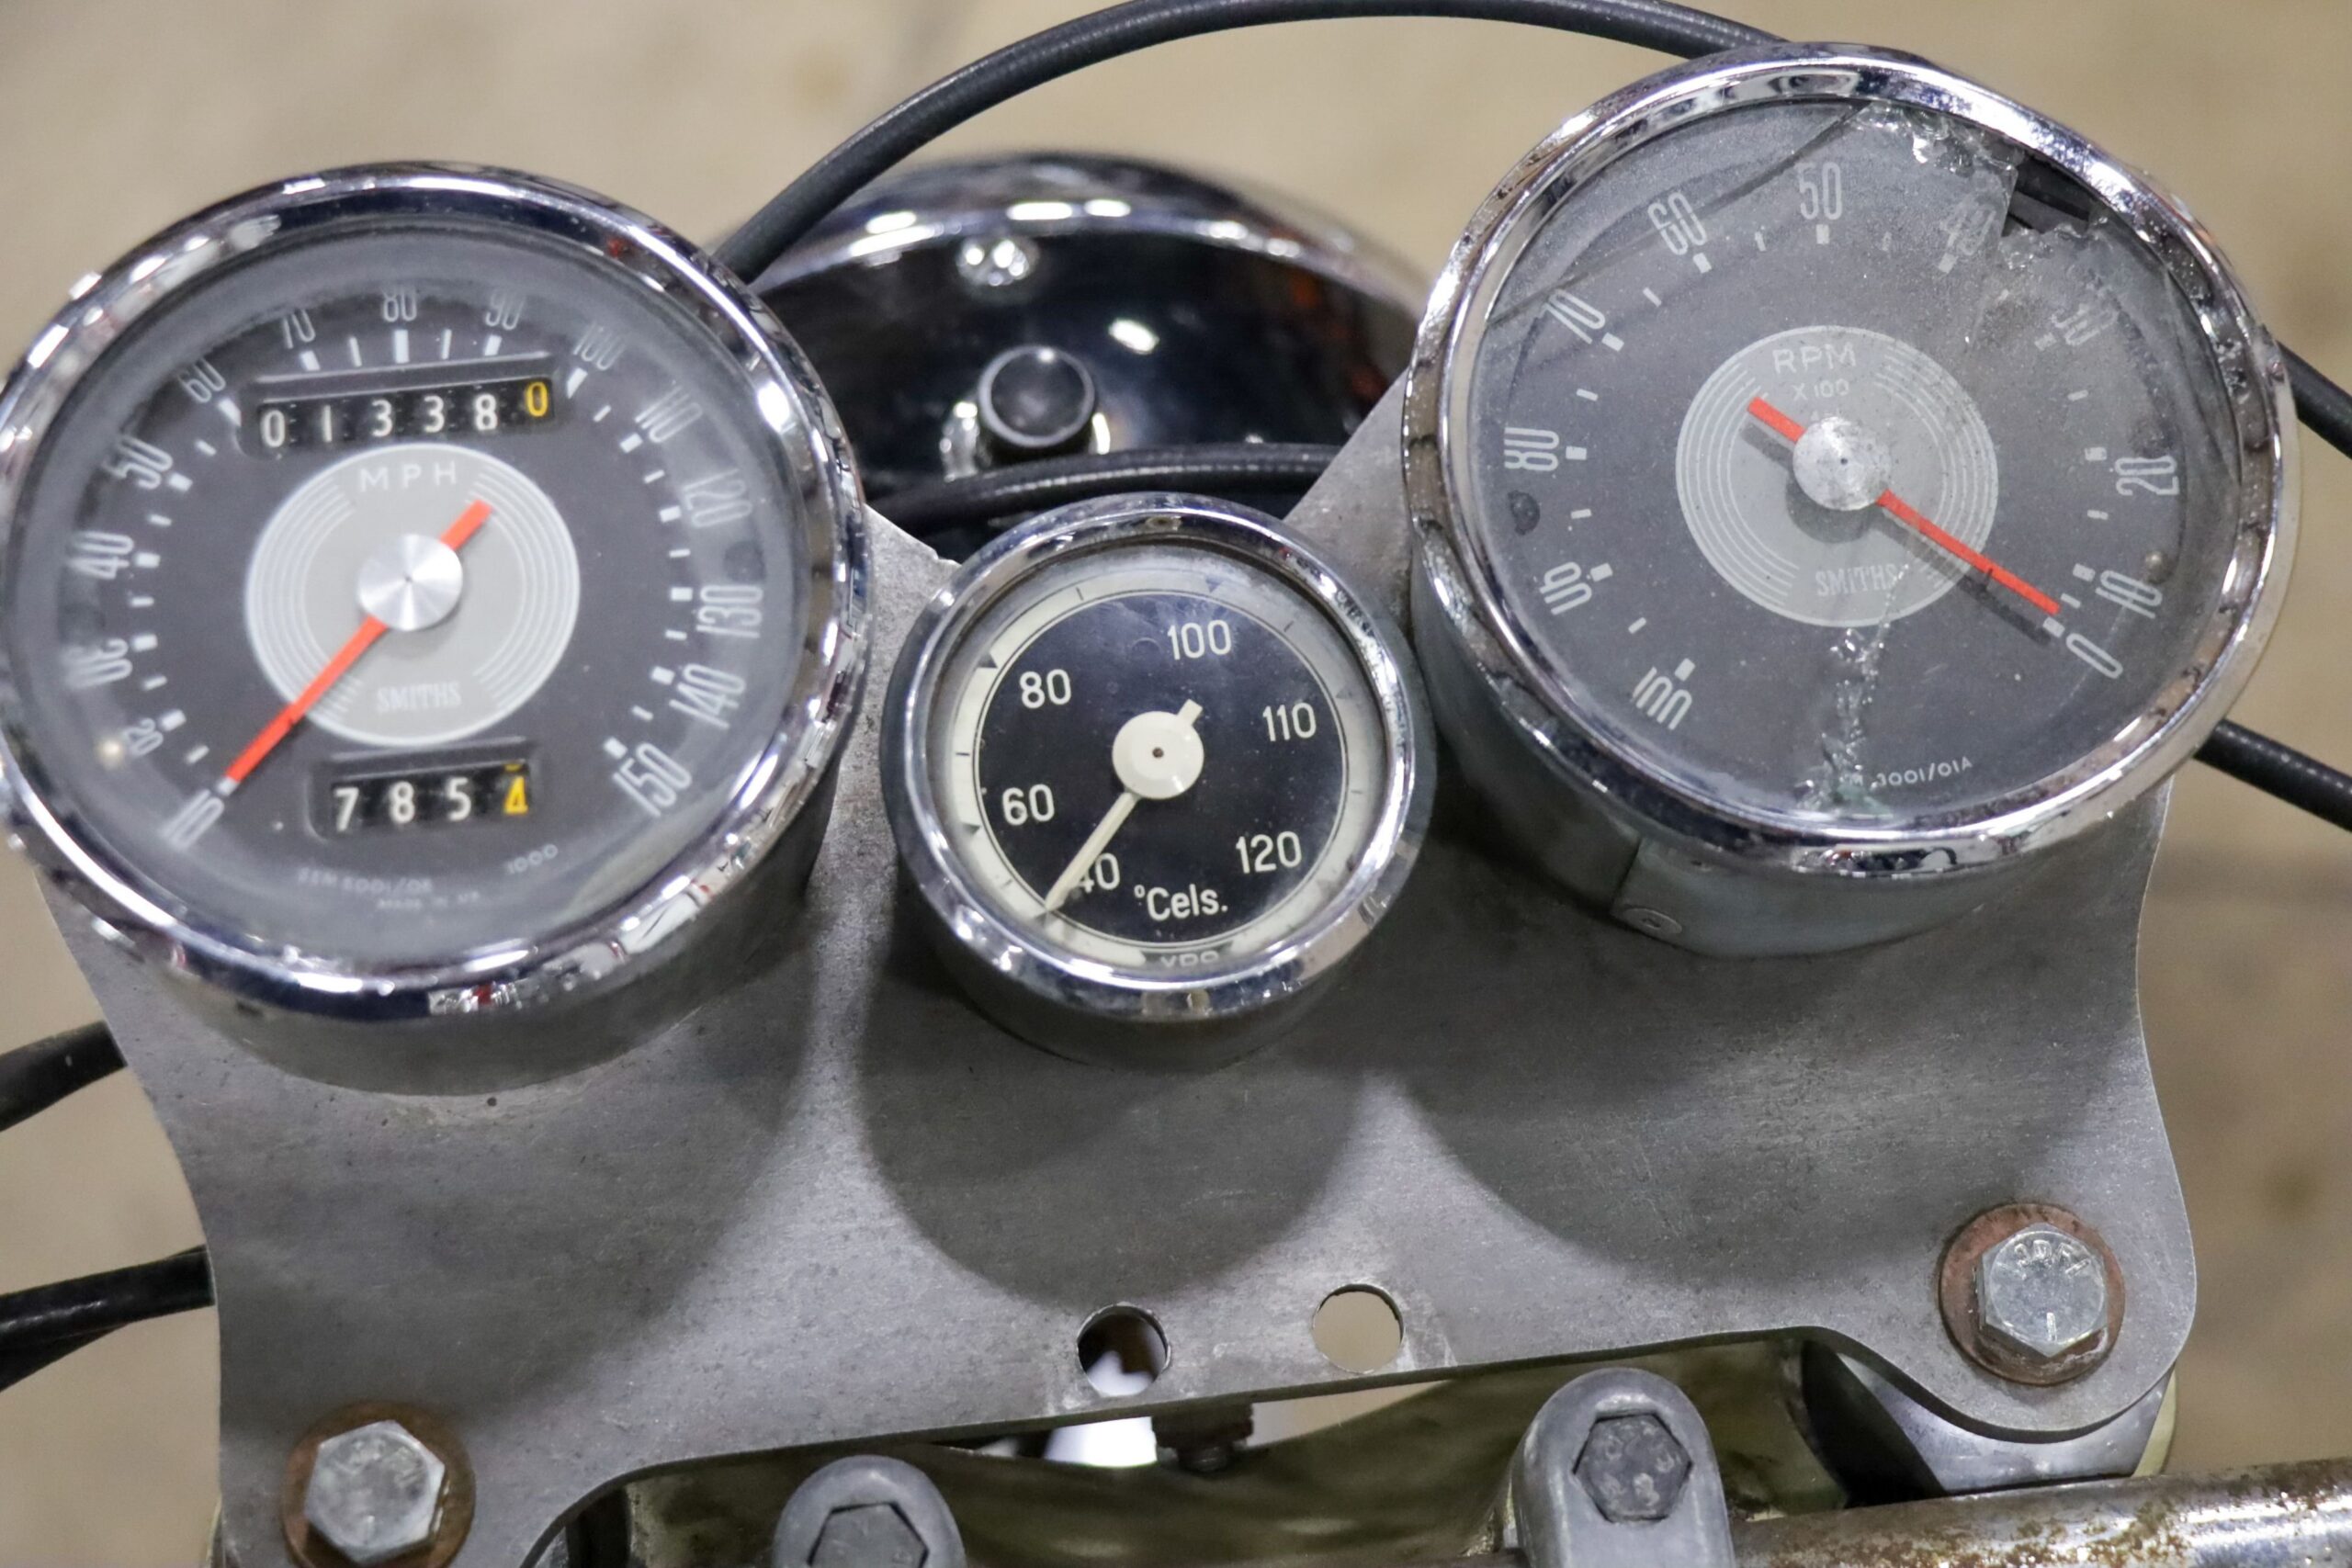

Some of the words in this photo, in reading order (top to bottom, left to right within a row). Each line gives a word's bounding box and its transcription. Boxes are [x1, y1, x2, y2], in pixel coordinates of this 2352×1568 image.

[1797, 163, 1843, 220] 50
[1647, 192, 1708, 255] 60
[382, 288, 417, 322] 80
[485, 289, 526, 331] 90
[1544, 288, 1606, 344] 70
[573, 321, 628, 371] 100
[1772, 342, 1856, 374] RPM
[177, 357, 227, 403] 60
[1814, 378, 1849, 398] 100
[635, 386, 703, 443] 110
[100, 433, 173, 490] 50
[1503, 427, 1559, 472] 80
[359, 460, 457, 492] MPH
[684, 468, 753, 528] 120
[2115, 456, 2179, 496] 20
[67, 530, 134, 580] 40
[1540, 561, 1592, 615] 90
[1815, 563, 1897, 597] SMITHS
[2095, 570, 2163, 618] 10
[696, 584, 763, 638] 130
[1167, 619, 1232, 660] 100
[2066, 633, 2123, 678] 0
[377, 682, 461, 713] SMITHS
[669, 662, 746, 730] 140
[1019, 669, 1072, 709] 80
[1633, 667, 1692, 730] 100
[1261, 702, 1317, 742] 110
[612, 742, 693, 817] 150
[158, 788, 225, 851] 10
[1001, 784, 1055, 825] 60
[1236, 830, 1303, 874] 120
[1160, 950, 1220, 967] VDO
